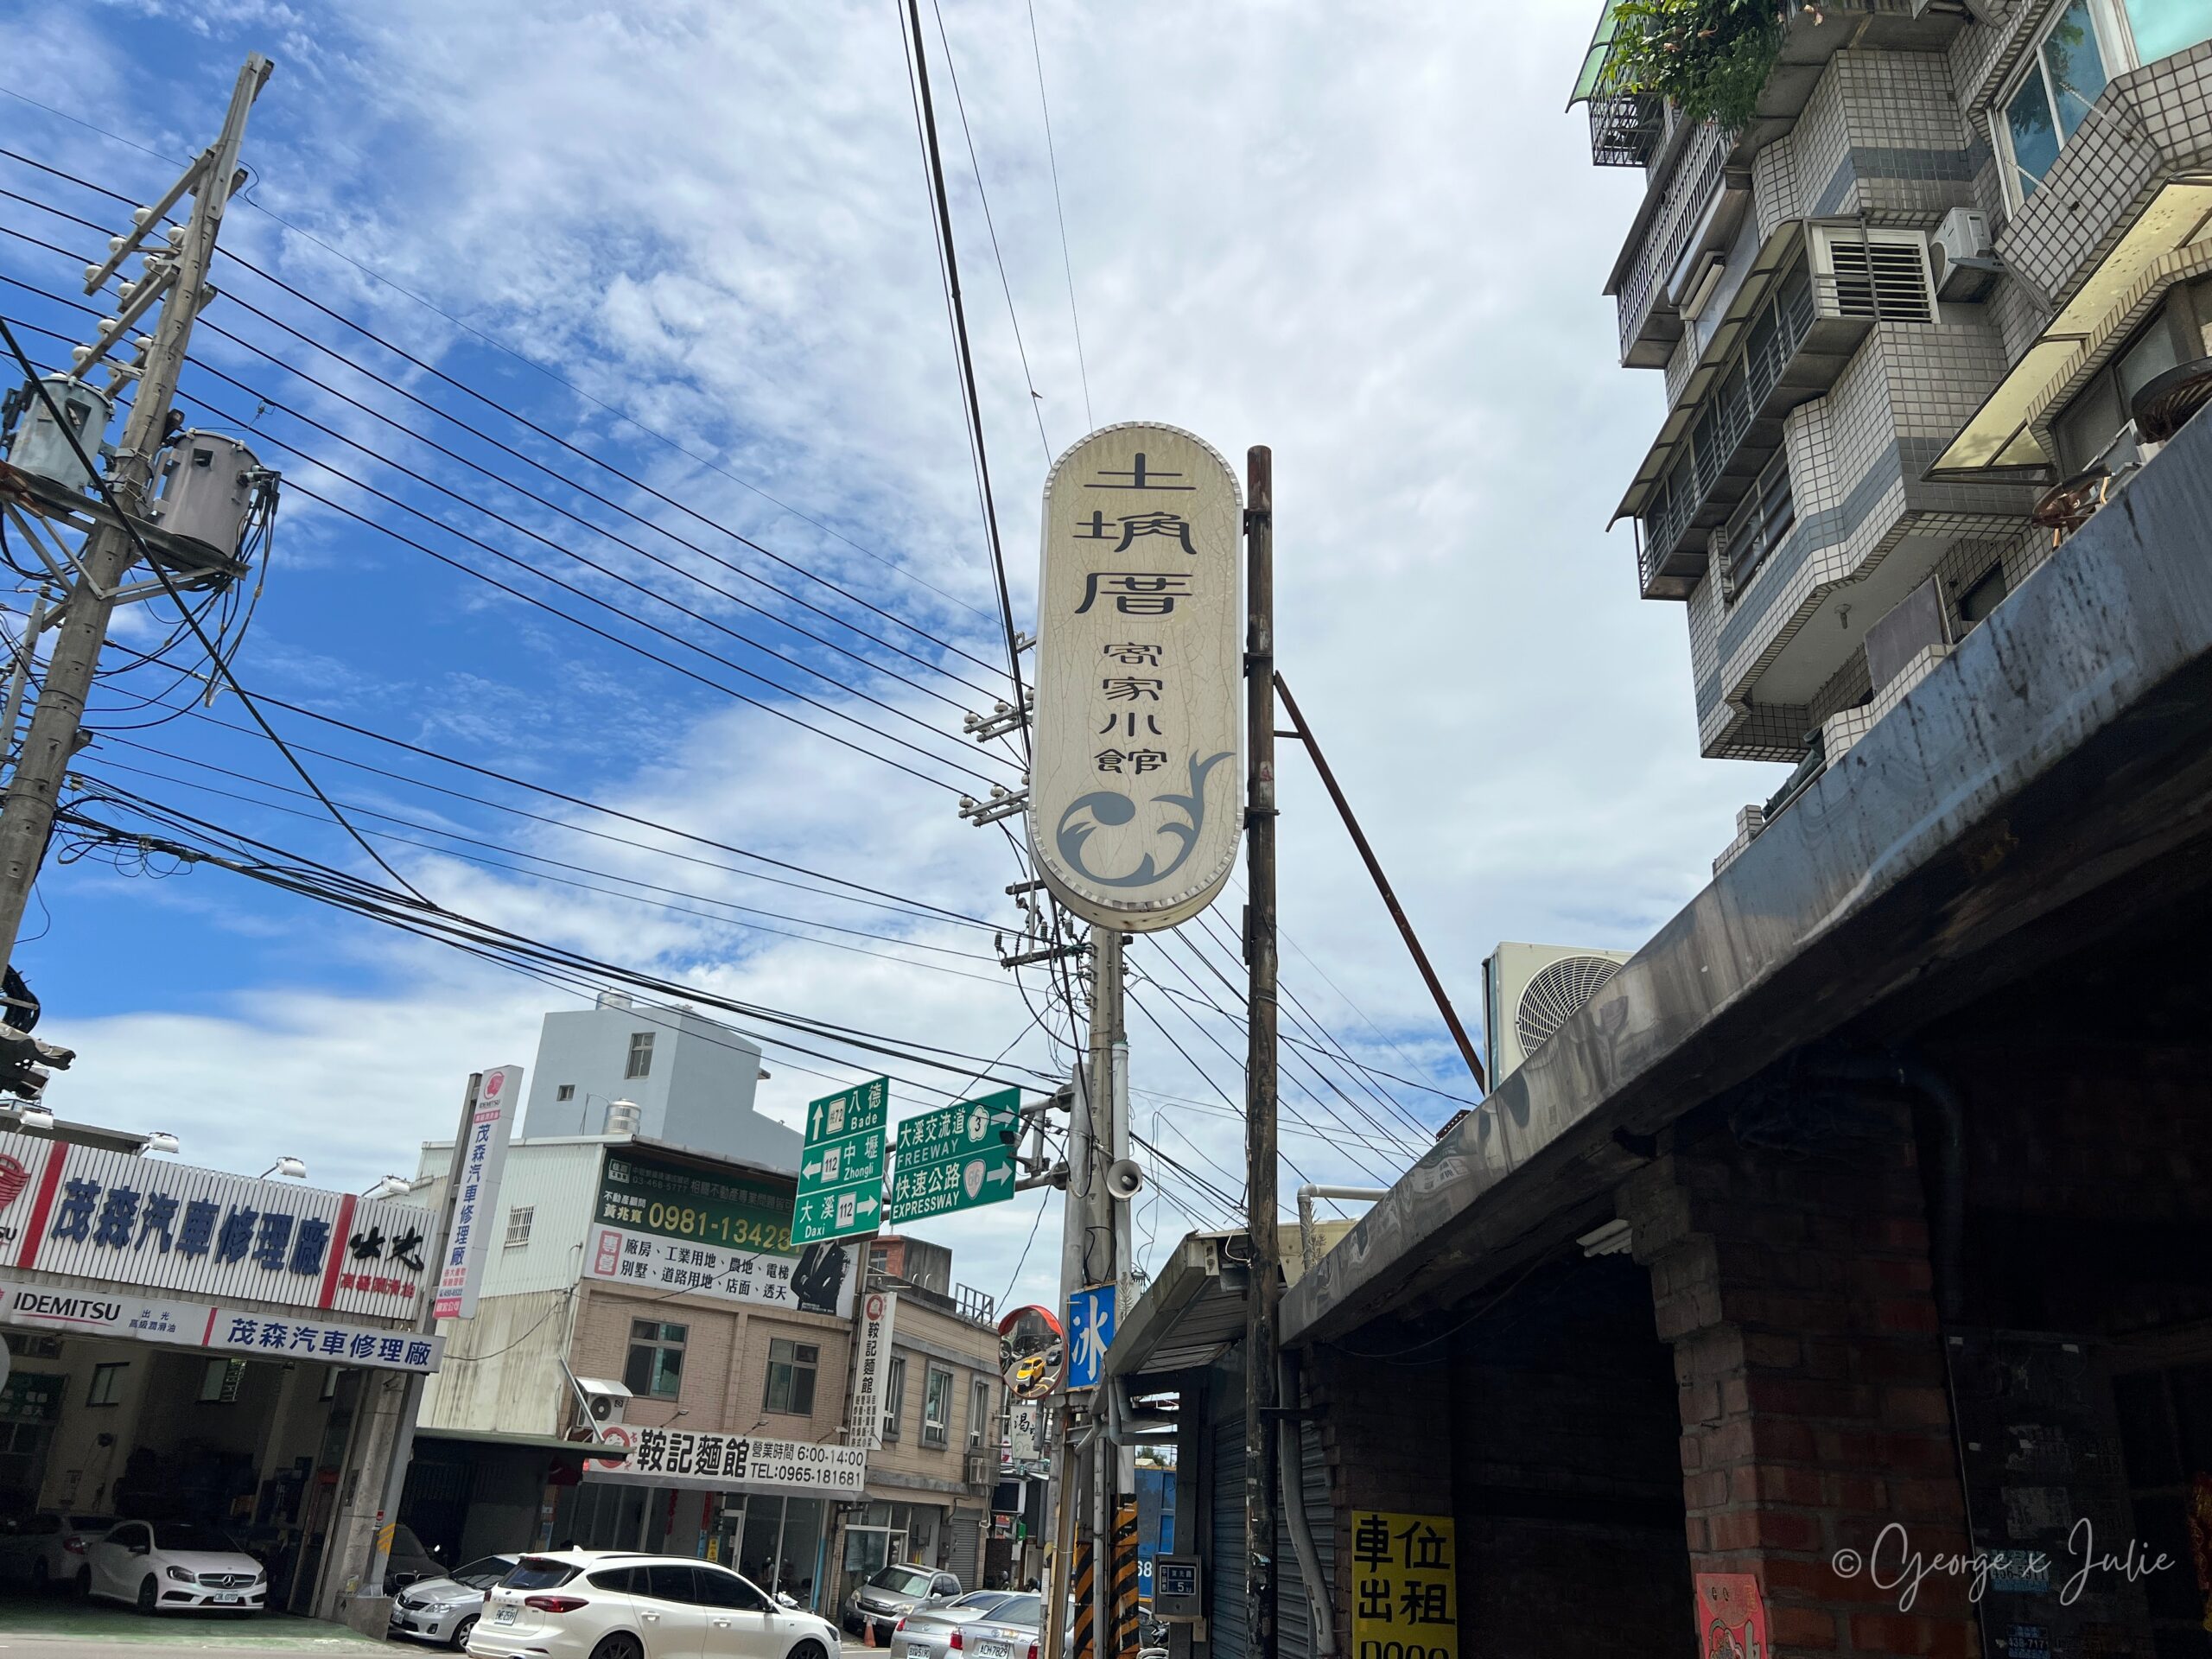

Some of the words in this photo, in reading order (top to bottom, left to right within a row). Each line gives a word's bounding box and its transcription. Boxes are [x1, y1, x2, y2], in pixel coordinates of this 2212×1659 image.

[1094, 641, 1168, 776] 客家小館
[848, 1082, 882, 1114] 八德
[850, 1113, 879, 1130] Bade
[899, 1106, 966, 1150] 大溪交流道
[974, 1116, 982, 1132] 3
[823, 1157, 838, 1173] 112
[843, 1134, 879, 1166] 中壢
[897, 1139, 959, 1169] FREEWAY
[843, 1161, 874, 1181] Zhongli
[895, 1162, 962, 1203] 快速公路
[449, 1123, 492, 1267] 茂森汽車修理廠
[799, 1194, 835, 1224] 大溪
[893, 1192, 961, 1220] EXPRESSWAY
[838, 1202, 854, 1219] 112
[51, 1177, 330, 1276] 茂森汽車修理廠
[804, 1223, 826, 1239] Daxi
[13, 1292, 121, 1321] IDEMITSU
[141, 1309, 169, 1321] 出光
[129, 1319, 176, 1333] 高級潤滑油
[1071, 1294, 1109, 1381] 冰
[227, 1318, 432, 1366] 茂森汽車修理廠
[861, 1321, 880, 1394] 鞍記麵館
[637, 1429, 750, 1478] 鞍記麵館
[752, 1440, 794, 1461] 營業時間
[797, 1446, 864, 1466] 6:00-14:00
[750, 1462, 861, 1486] TEL:0965-181681
[1354, 1514, 1451, 1573] 車位
[1358, 1579, 1456, 1625] 出租
